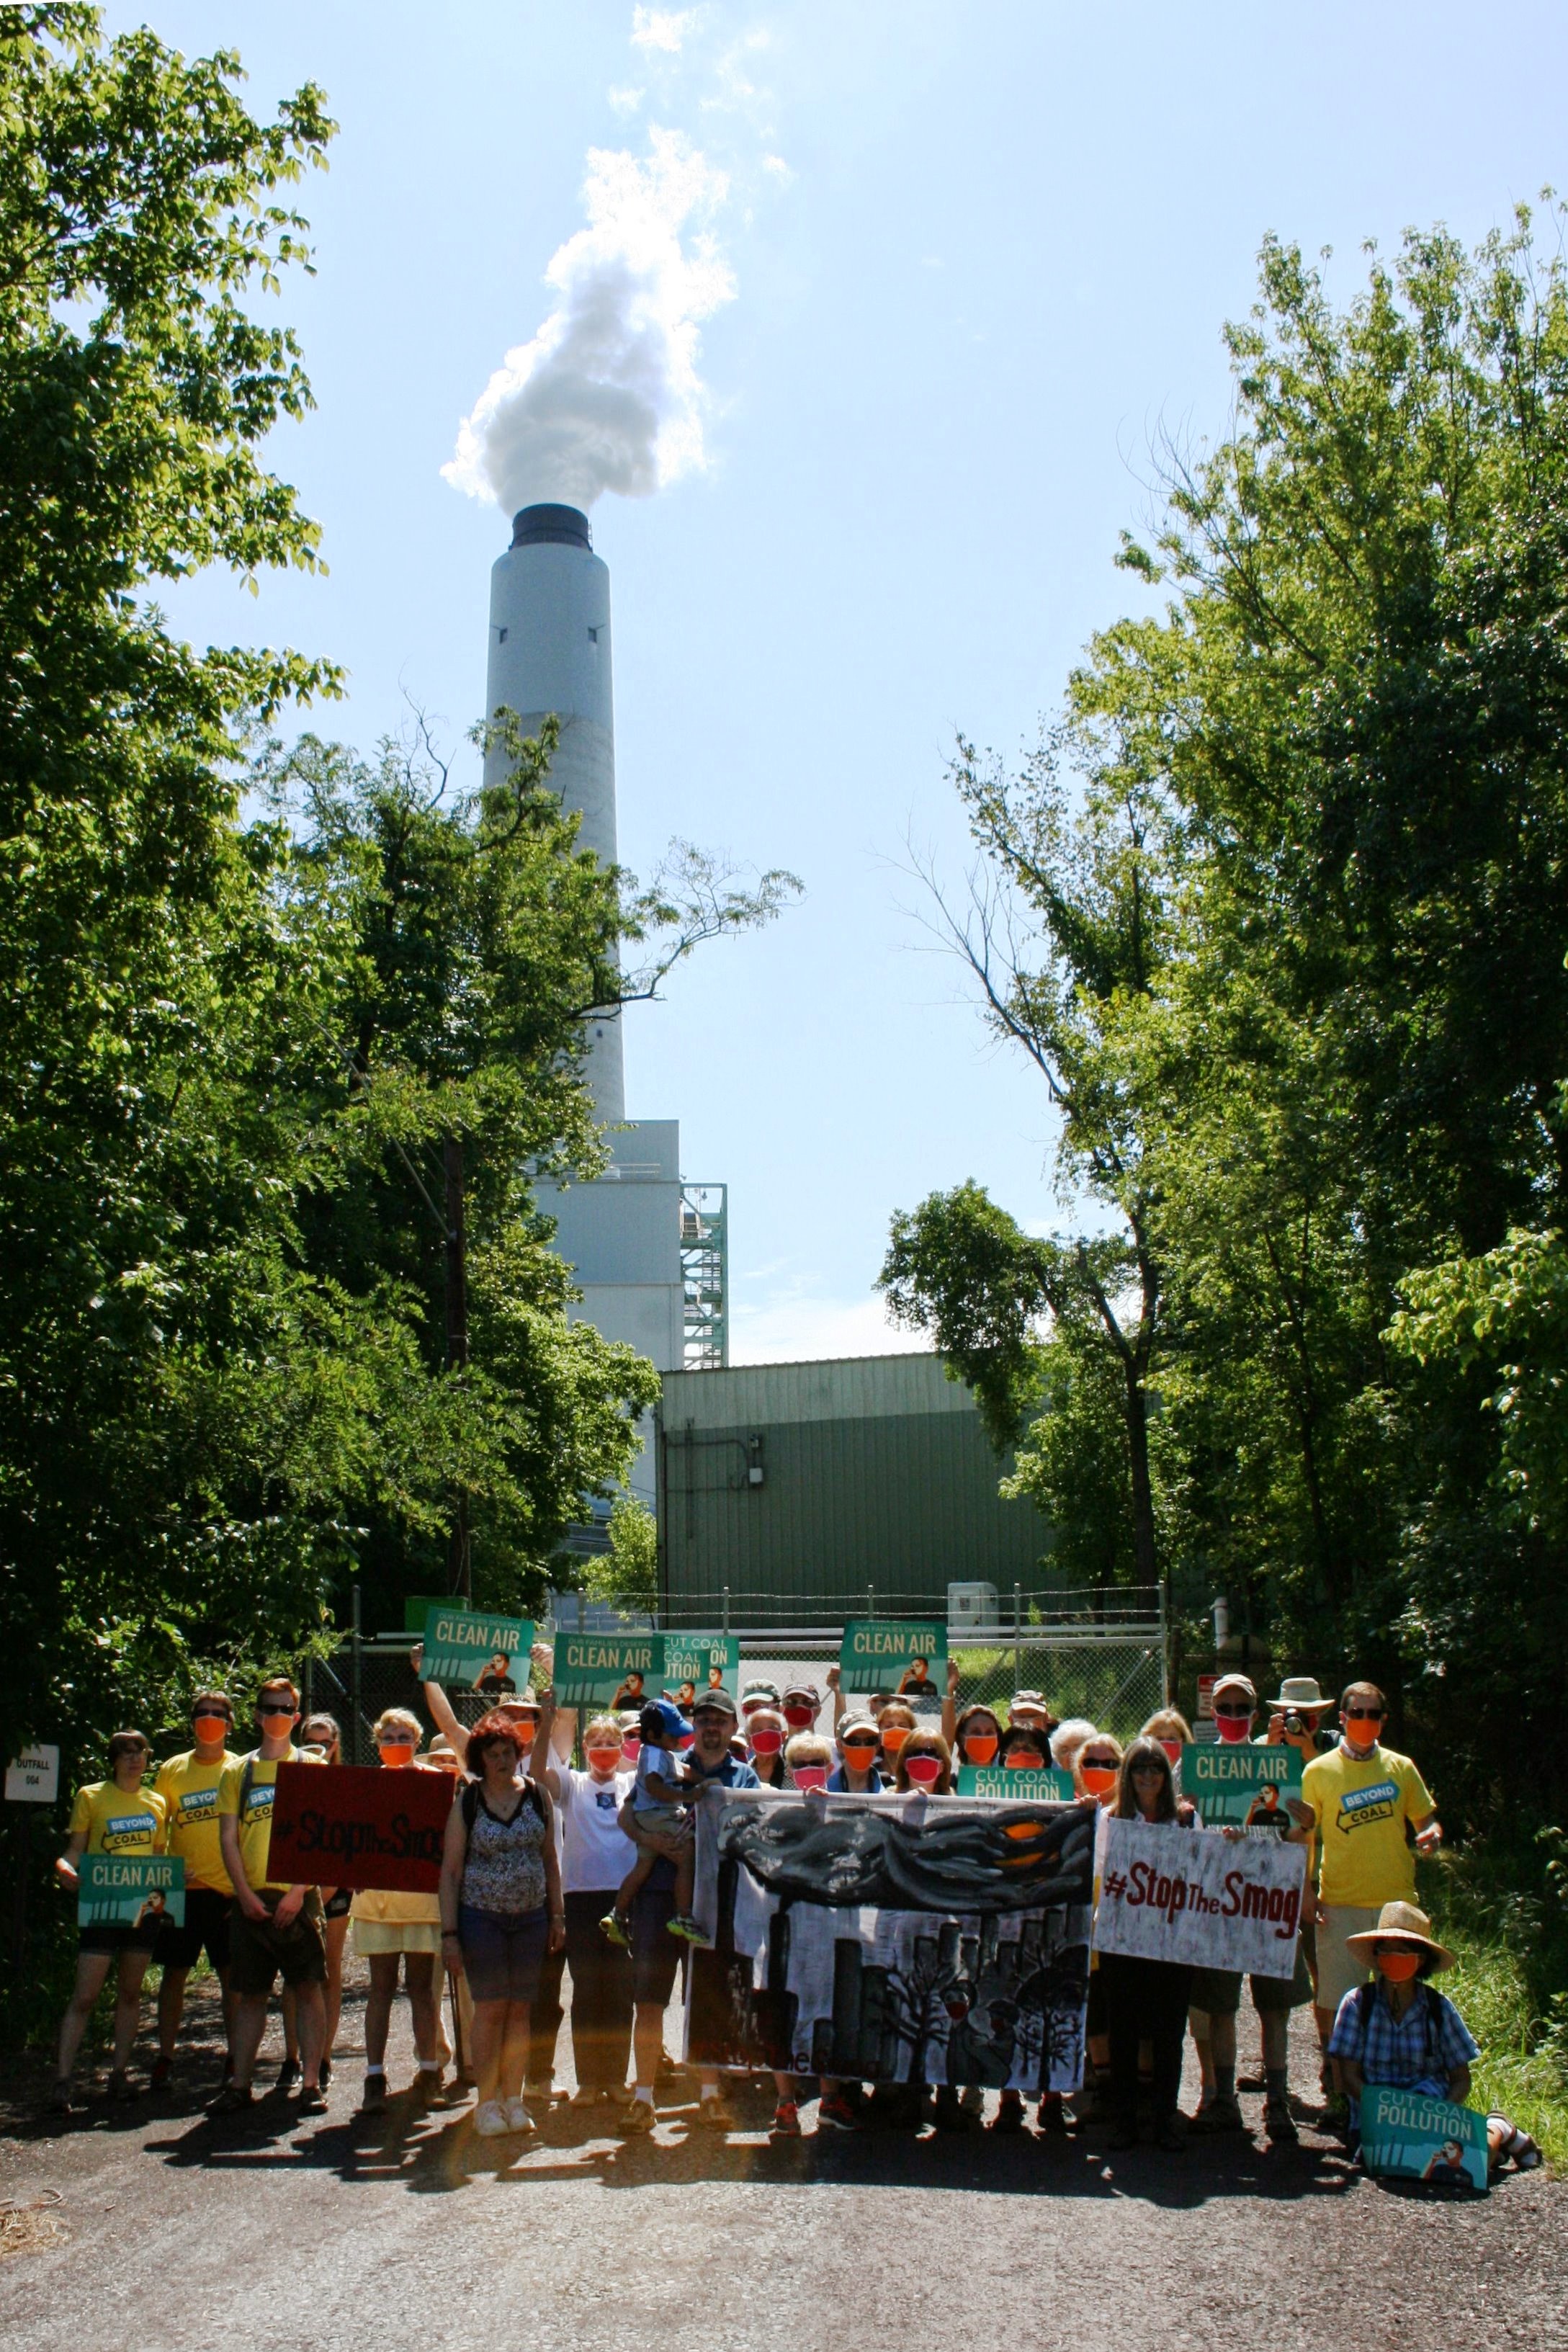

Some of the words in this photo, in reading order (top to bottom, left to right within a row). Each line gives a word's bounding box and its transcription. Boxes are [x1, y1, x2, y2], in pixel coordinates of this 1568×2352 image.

[436, 1621, 488, 1647] CLEAN
[490, 1628, 520, 1651] AIR
[691, 1638, 728, 1650] COAL
[854, 1632, 905, 1653] CLEAN
[908, 1633, 936, 1654] AIR
[567, 1645, 619, 1668] CLEAN
[623, 1648, 652, 1669] AIR
[663, 1651, 701, 1663] COAL
[17, 1758, 50, 1770] OUTFALL
[1196, 1756, 1253, 1779] CLEAN
[1256, 1757, 1288, 1780] AIR
[975, 1769, 1008, 1783] CUT
[1014, 1771, 1059, 1784] COAL
[184, 1791, 218, 1807] BEYON
[1345, 1786, 1394, 1807] BEYOND
[111, 1817, 153, 1830] BEYOND
[1351, 1806, 1386, 1823] COAL
[114, 1833, 144, 1845] COAL
[92, 1866, 142, 1886] CLEAN
[145, 1867, 173, 1887] AIR
[1379, 2091, 1416, 2108] CUT
[1423, 2099, 1471, 2123] COAL
[1377, 2104, 1472, 2141] POLLUTION
